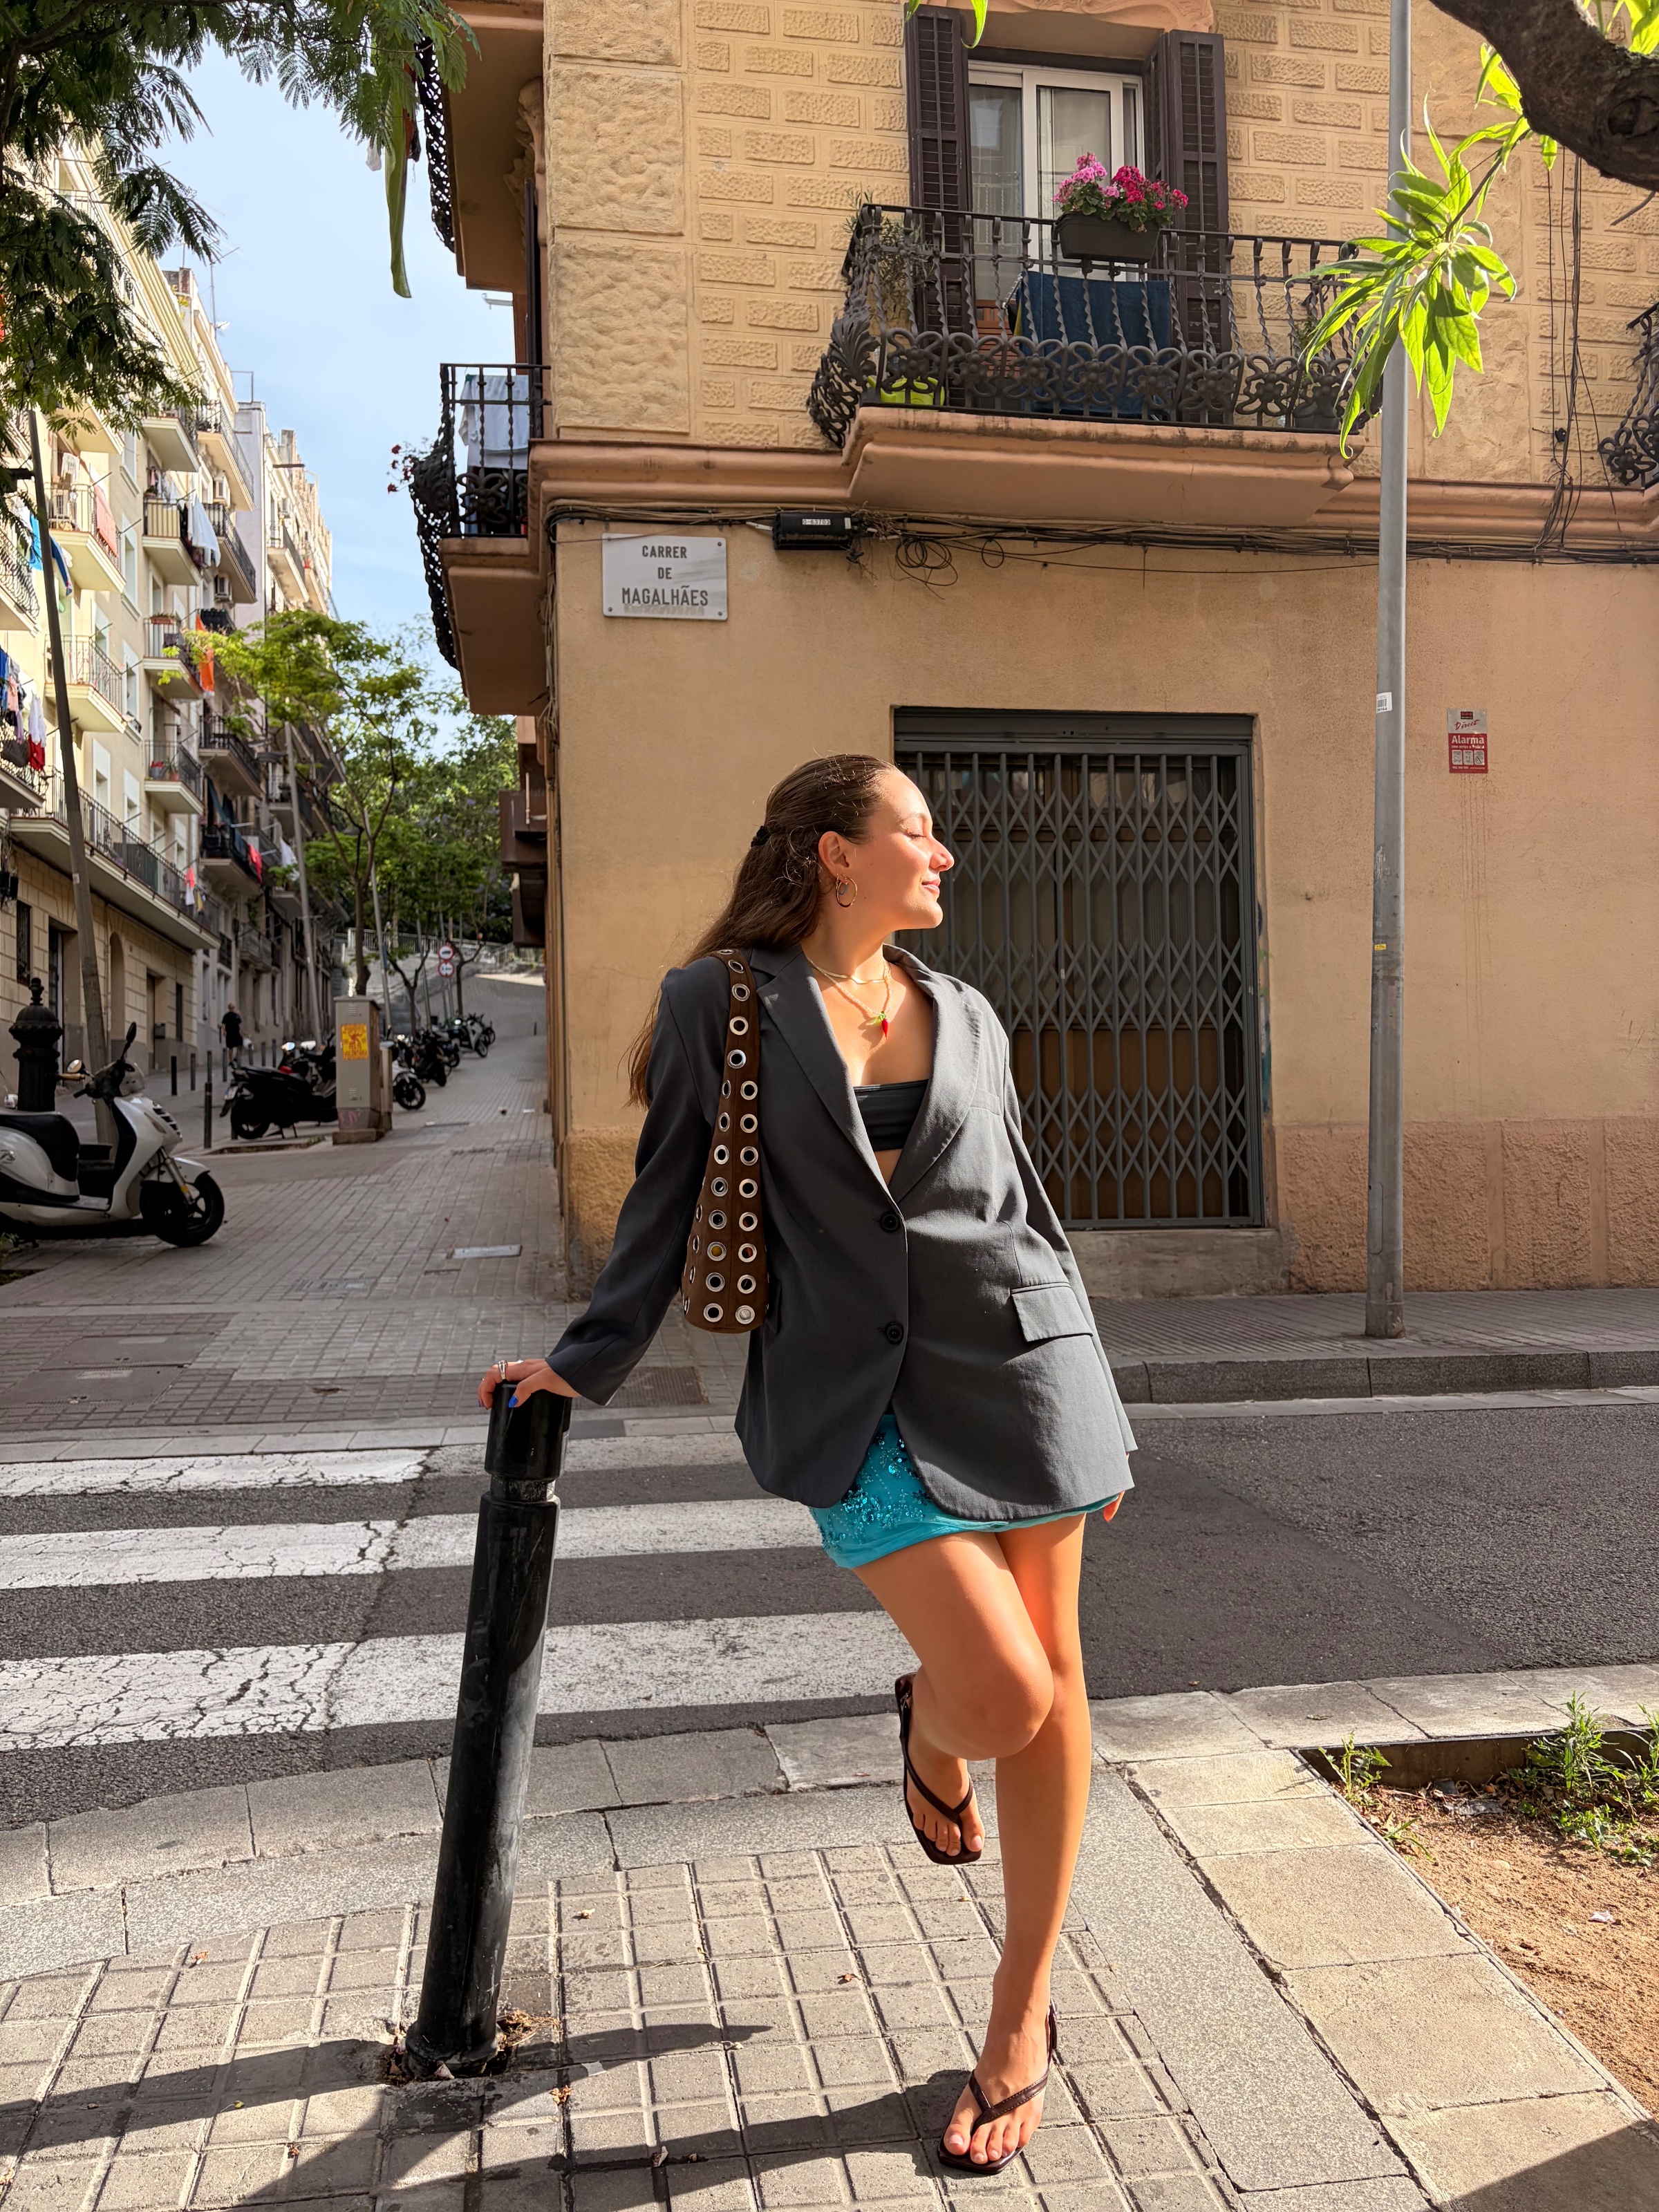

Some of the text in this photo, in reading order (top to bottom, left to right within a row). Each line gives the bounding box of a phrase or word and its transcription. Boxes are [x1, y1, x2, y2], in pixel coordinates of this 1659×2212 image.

[642, 545, 687, 559] CARRER
[657, 567, 672, 579] DE
[622, 585, 708, 606] MAGALHÃES
[1455, 720, 1480, 730] Direct
[1452, 735, 1484, 744] Alarma
